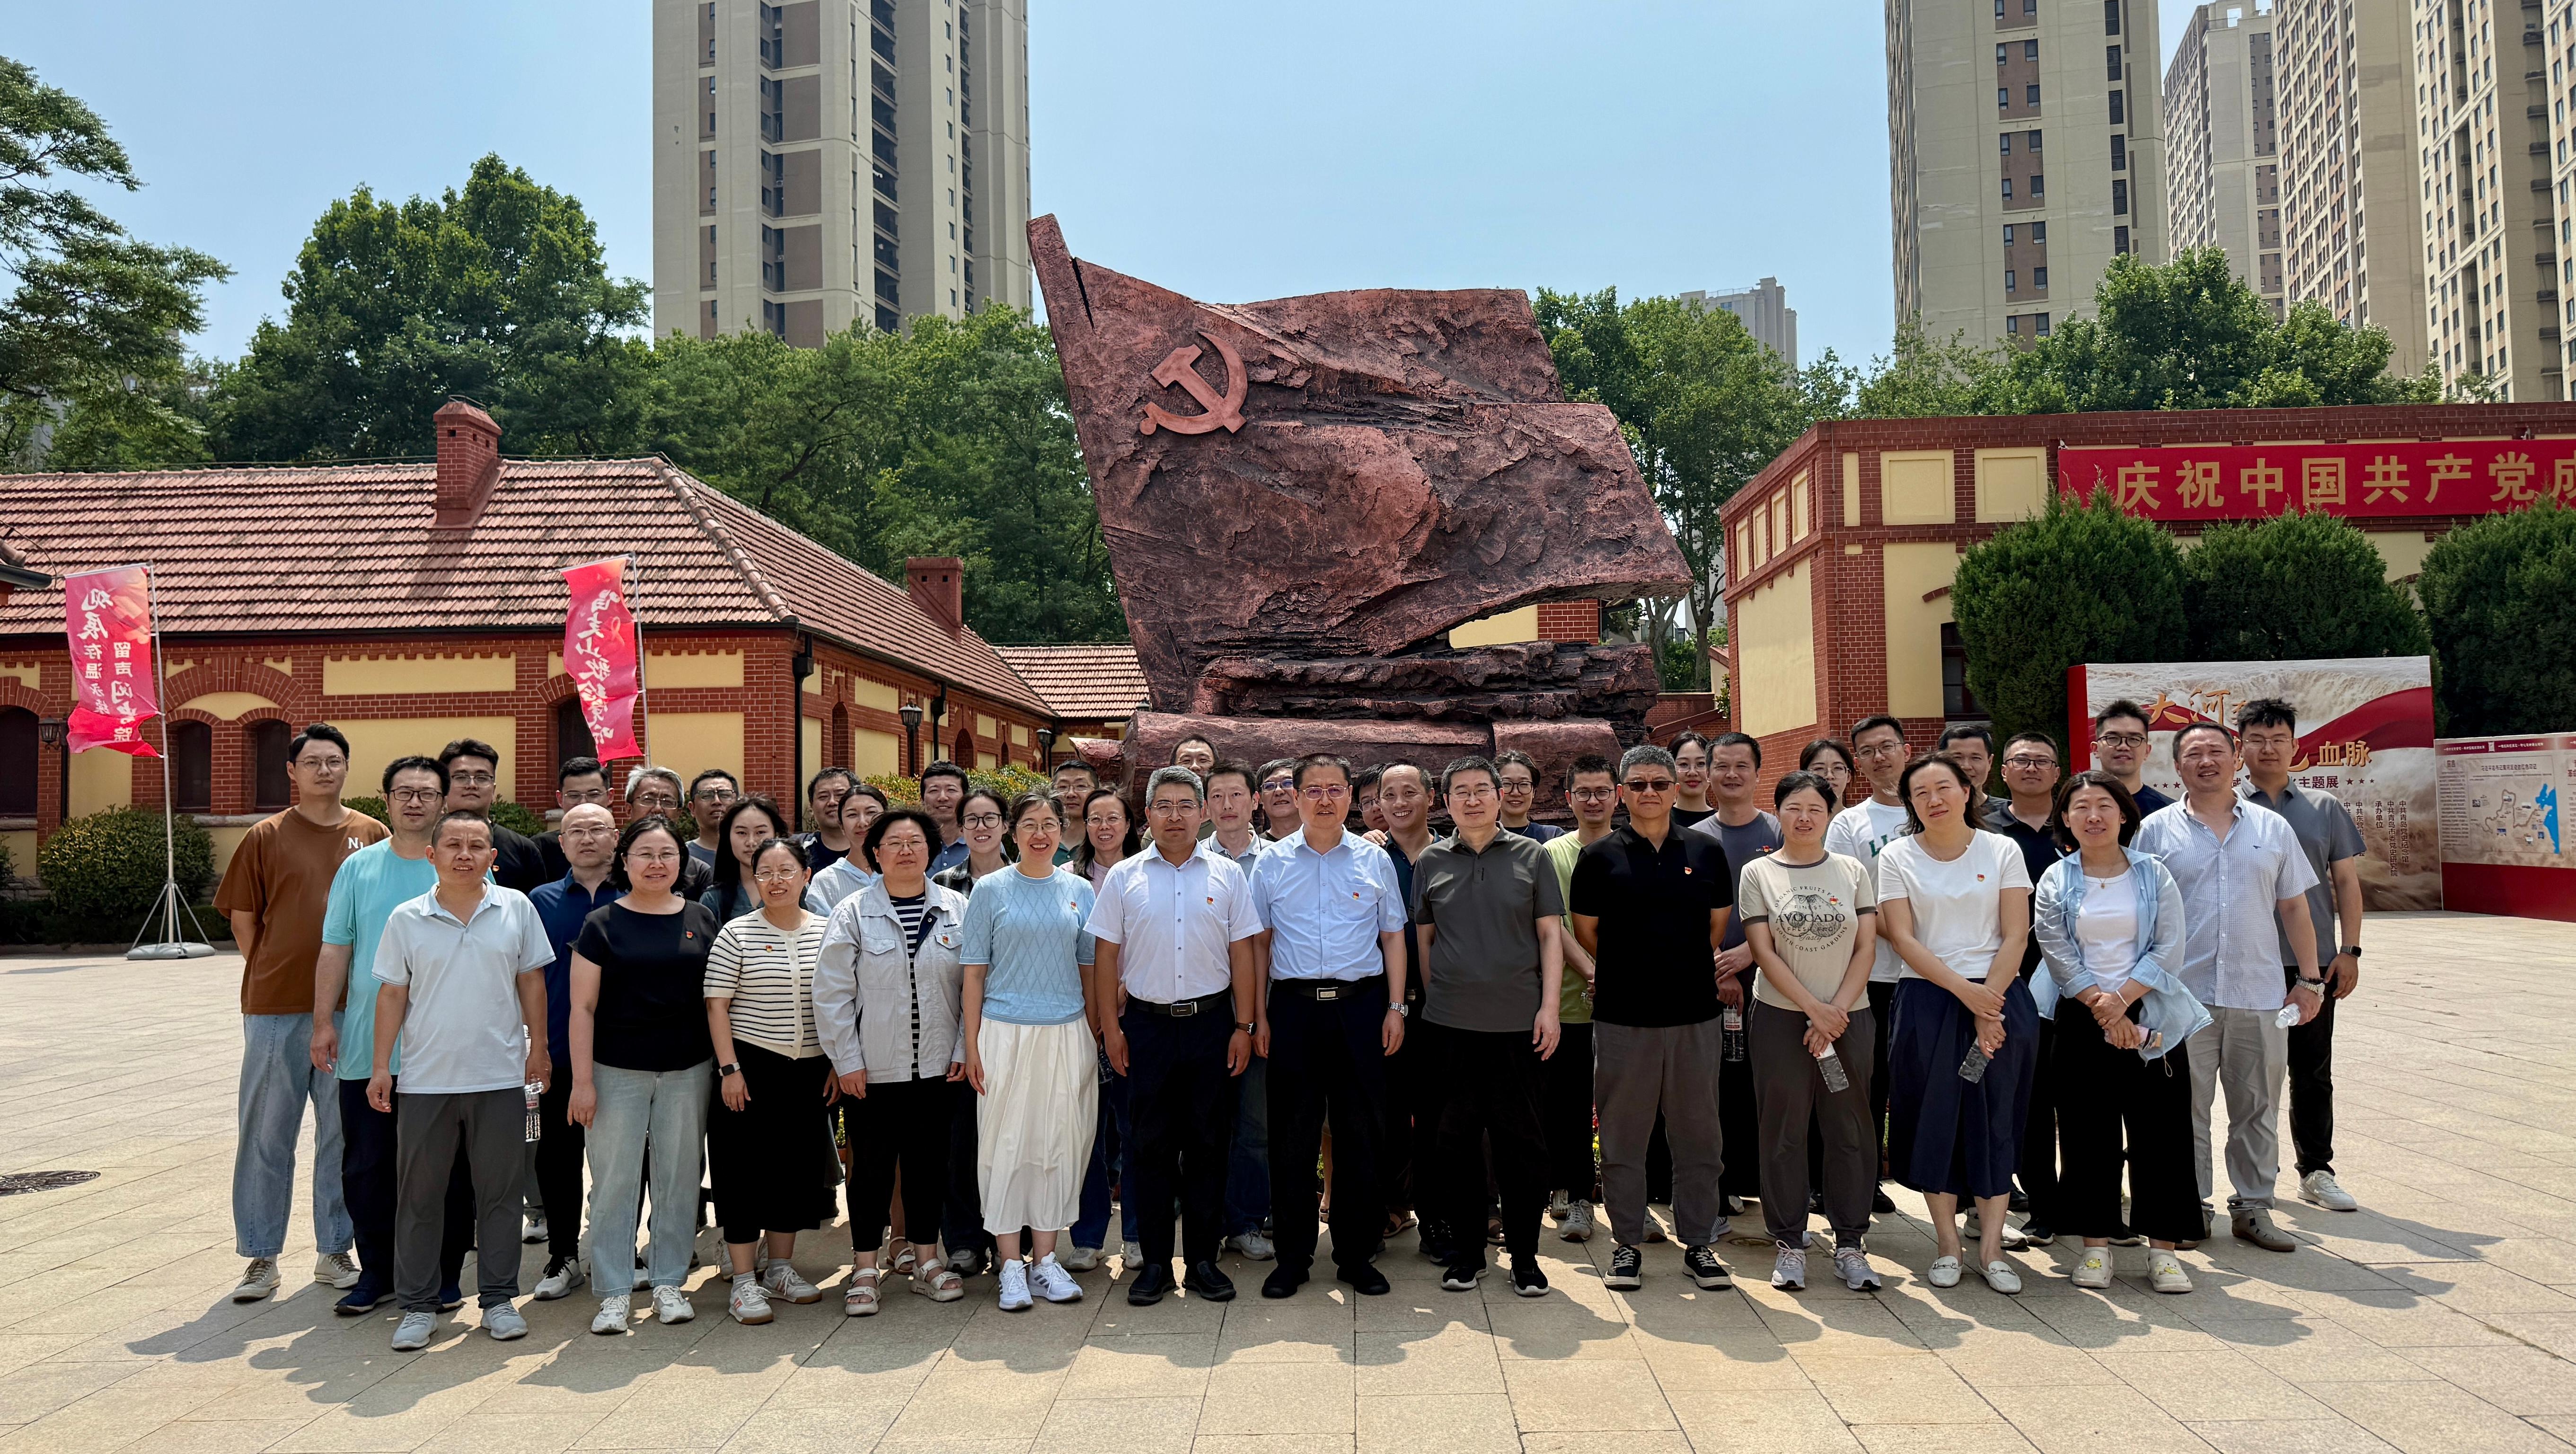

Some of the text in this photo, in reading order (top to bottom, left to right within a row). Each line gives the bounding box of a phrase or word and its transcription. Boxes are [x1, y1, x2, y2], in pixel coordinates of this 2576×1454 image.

[2293, 775, 2339, 789] 主题展
[2375, 801, 2383, 828] 承办单位
[1775, 887, 1798, 908] ORGANIC
[1775, 913, 1845, 924] AVOCADO
[1776, 927, 1793, 946] SOUTH
